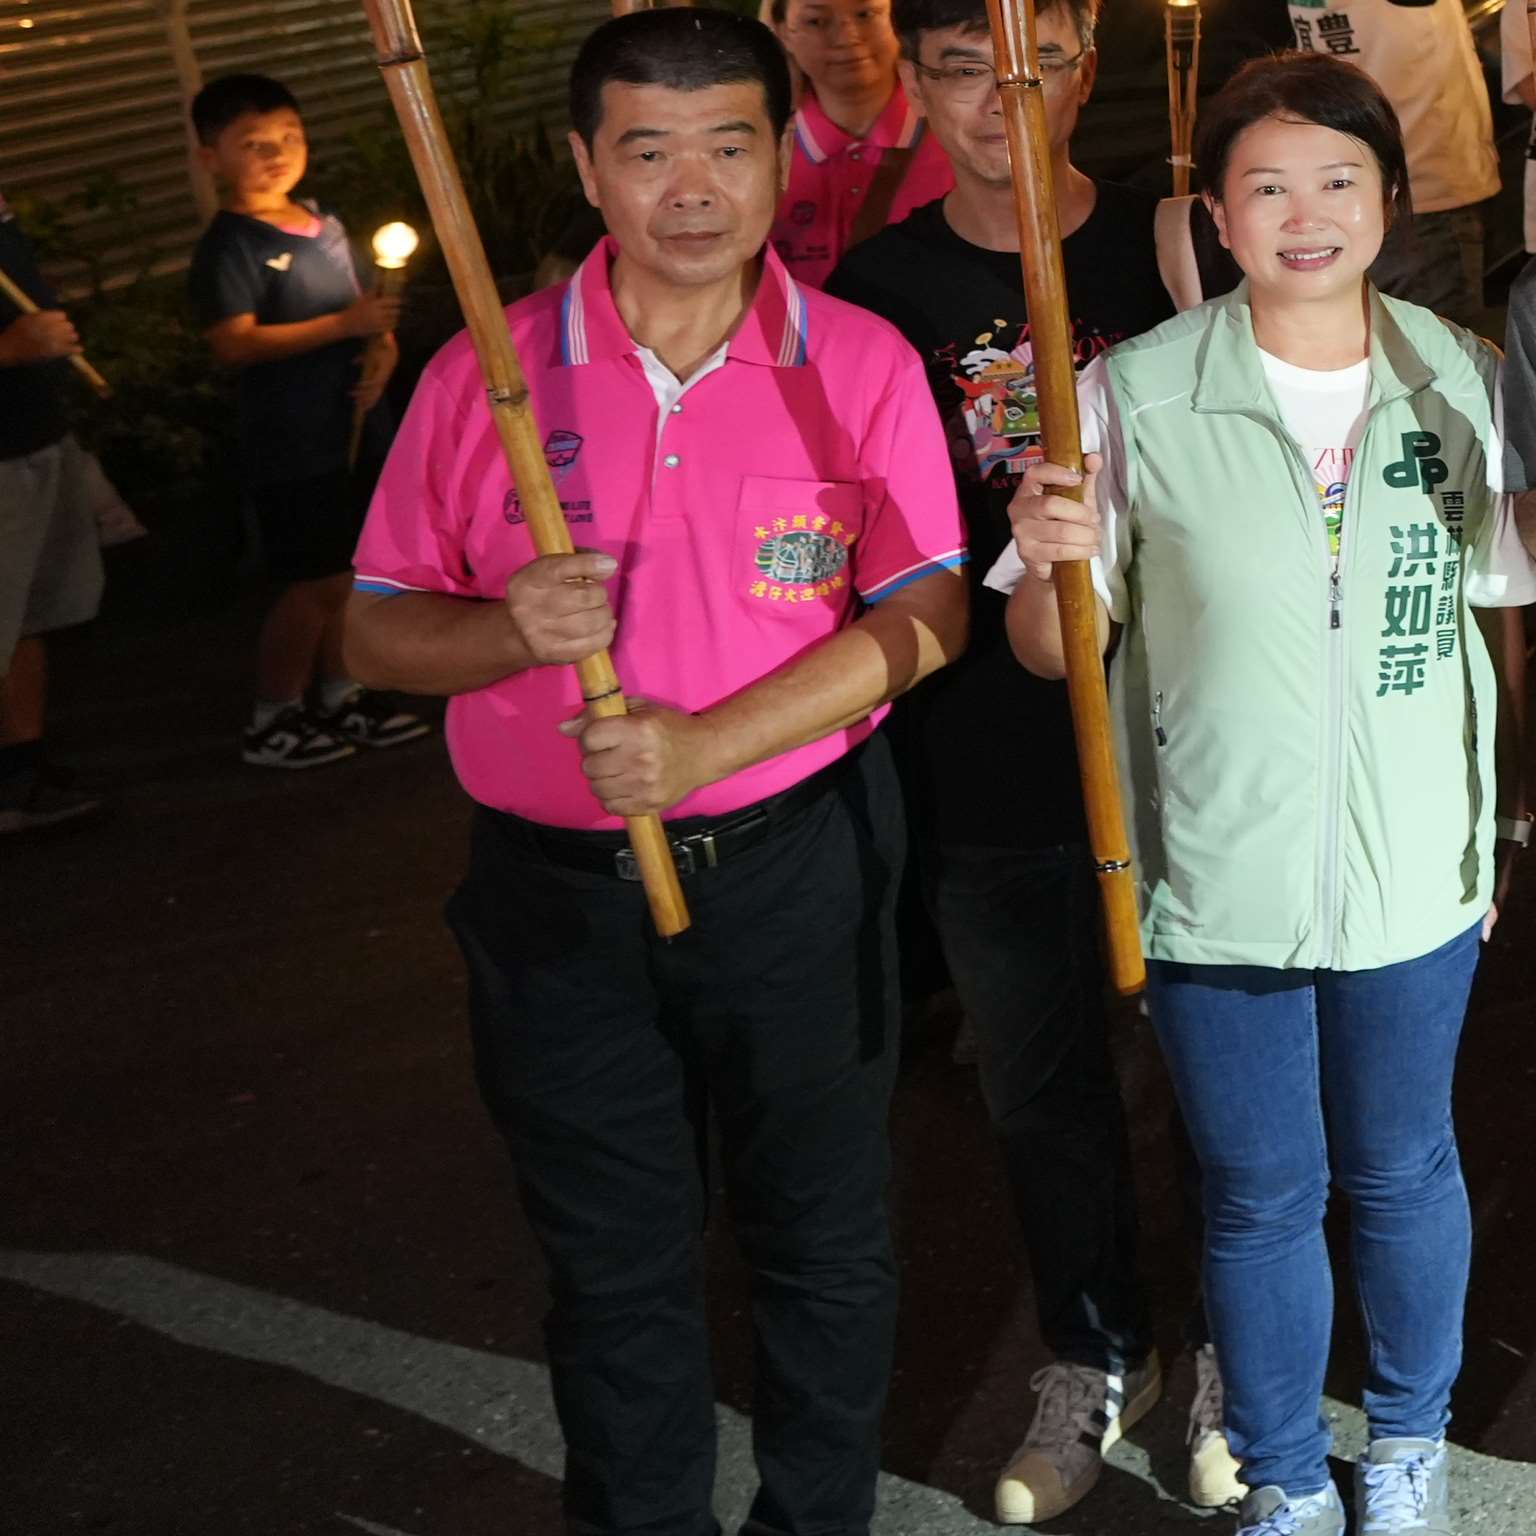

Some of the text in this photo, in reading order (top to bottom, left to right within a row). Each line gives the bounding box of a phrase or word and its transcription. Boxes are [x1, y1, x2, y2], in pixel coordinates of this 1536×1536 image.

[1376, 522, 1439, 697] 洪如萍
[1436, 491, 1464, 661] 雲林縣議員
